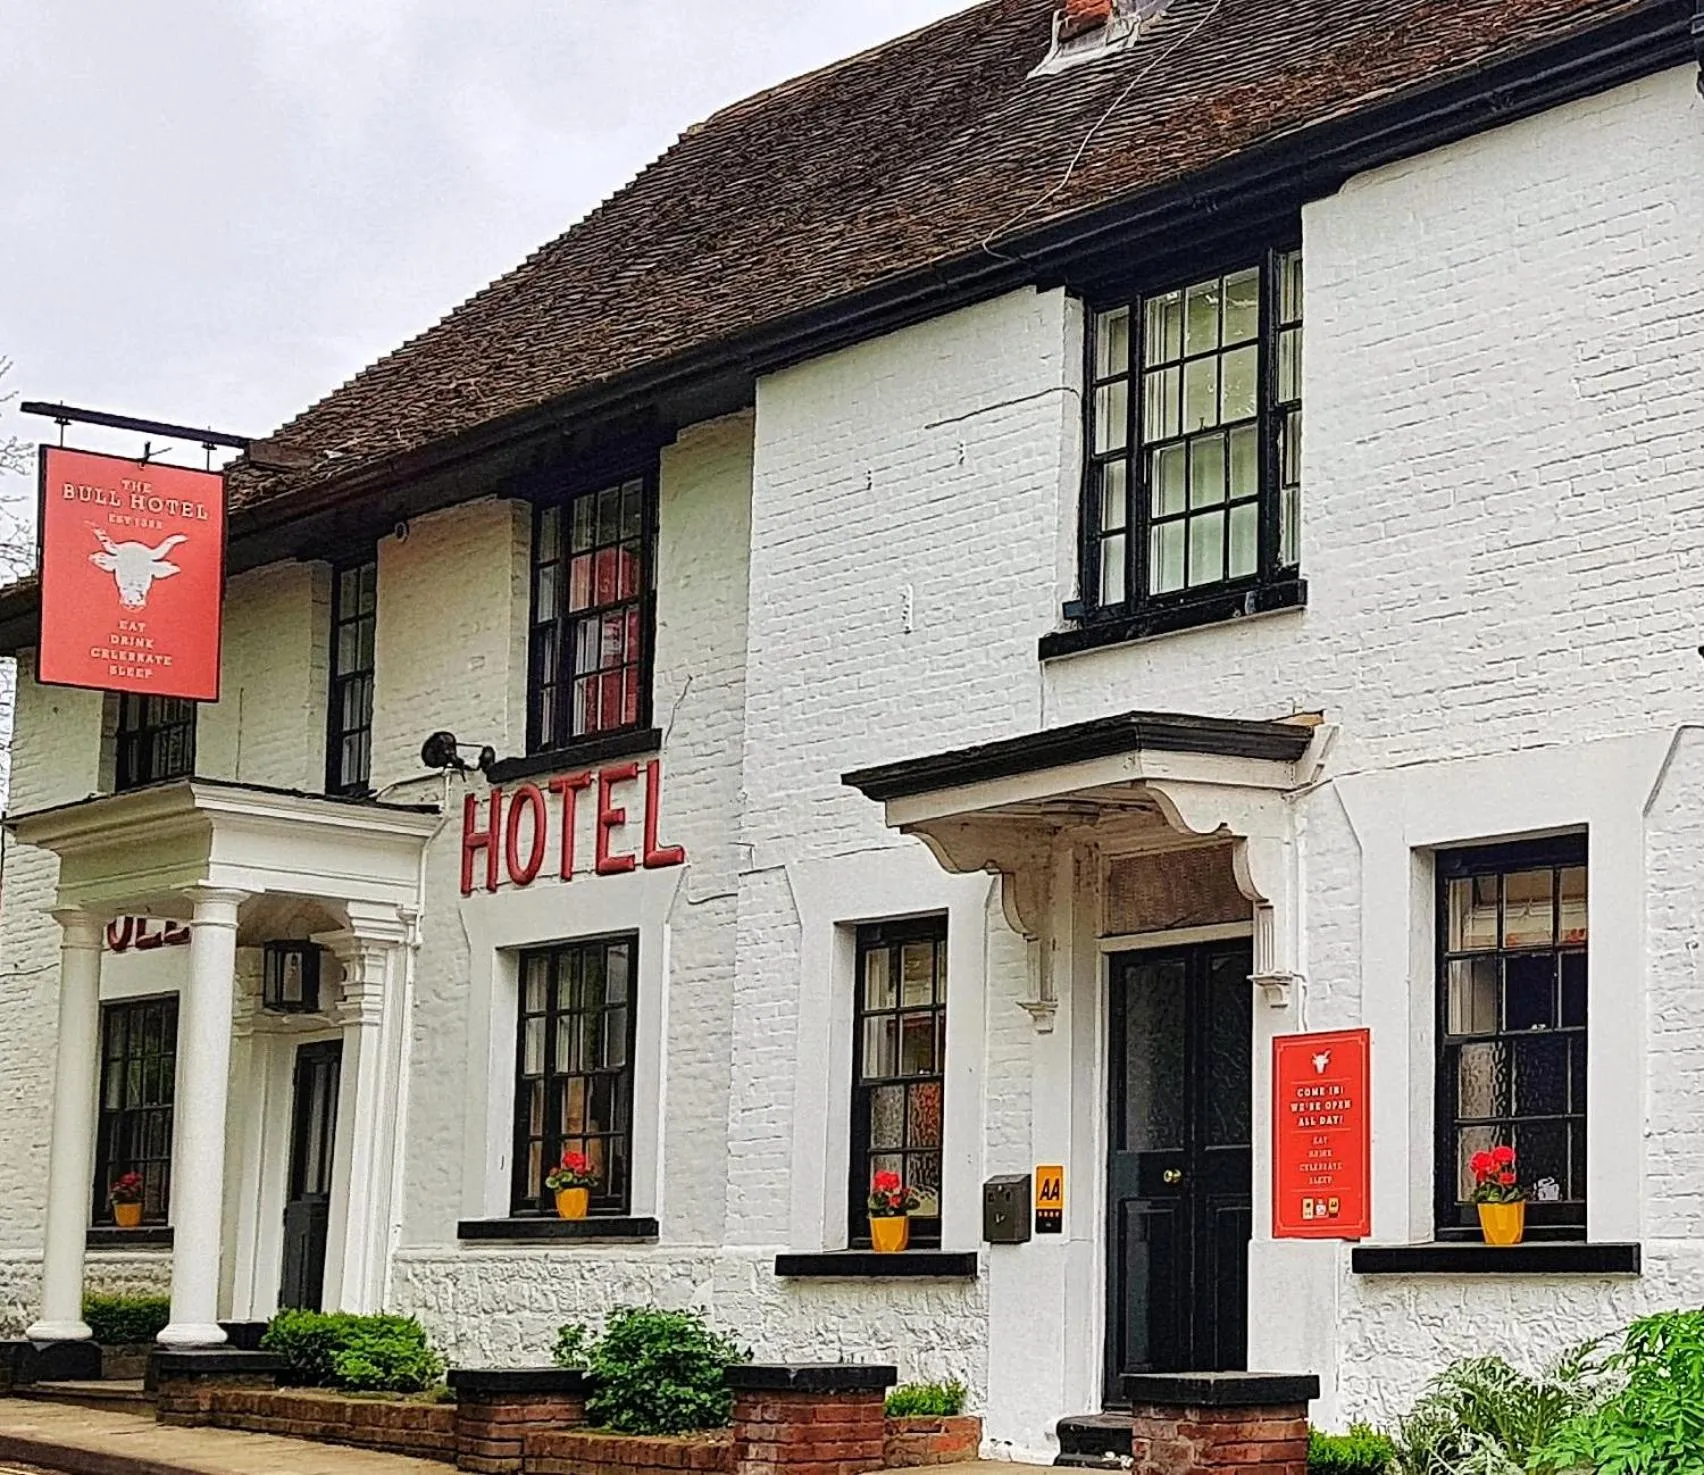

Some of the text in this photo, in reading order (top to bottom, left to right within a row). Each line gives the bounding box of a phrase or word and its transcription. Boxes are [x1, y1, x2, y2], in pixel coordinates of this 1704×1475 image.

[122, 479, 152, 493] THE
[63, 483, 208, 520] BULL HOTEL
[119, 620, 146, 633] EAT
[110, 634, 154, 649] DRINK
[90, 647, 172, 667] CELEBRATE
[109, 665, 153, 679] SLEEP
[461, 759, 685, 895] HOTEL
[107, 915, 190, 952] ULL
[1297, 1087, 1325, 1098] COME
[1325, 1100, 1351, 1110] OPEN
[1298, 1116, 1317, 1127] ALL
[1040, 1178, 1060, 1201] AA
